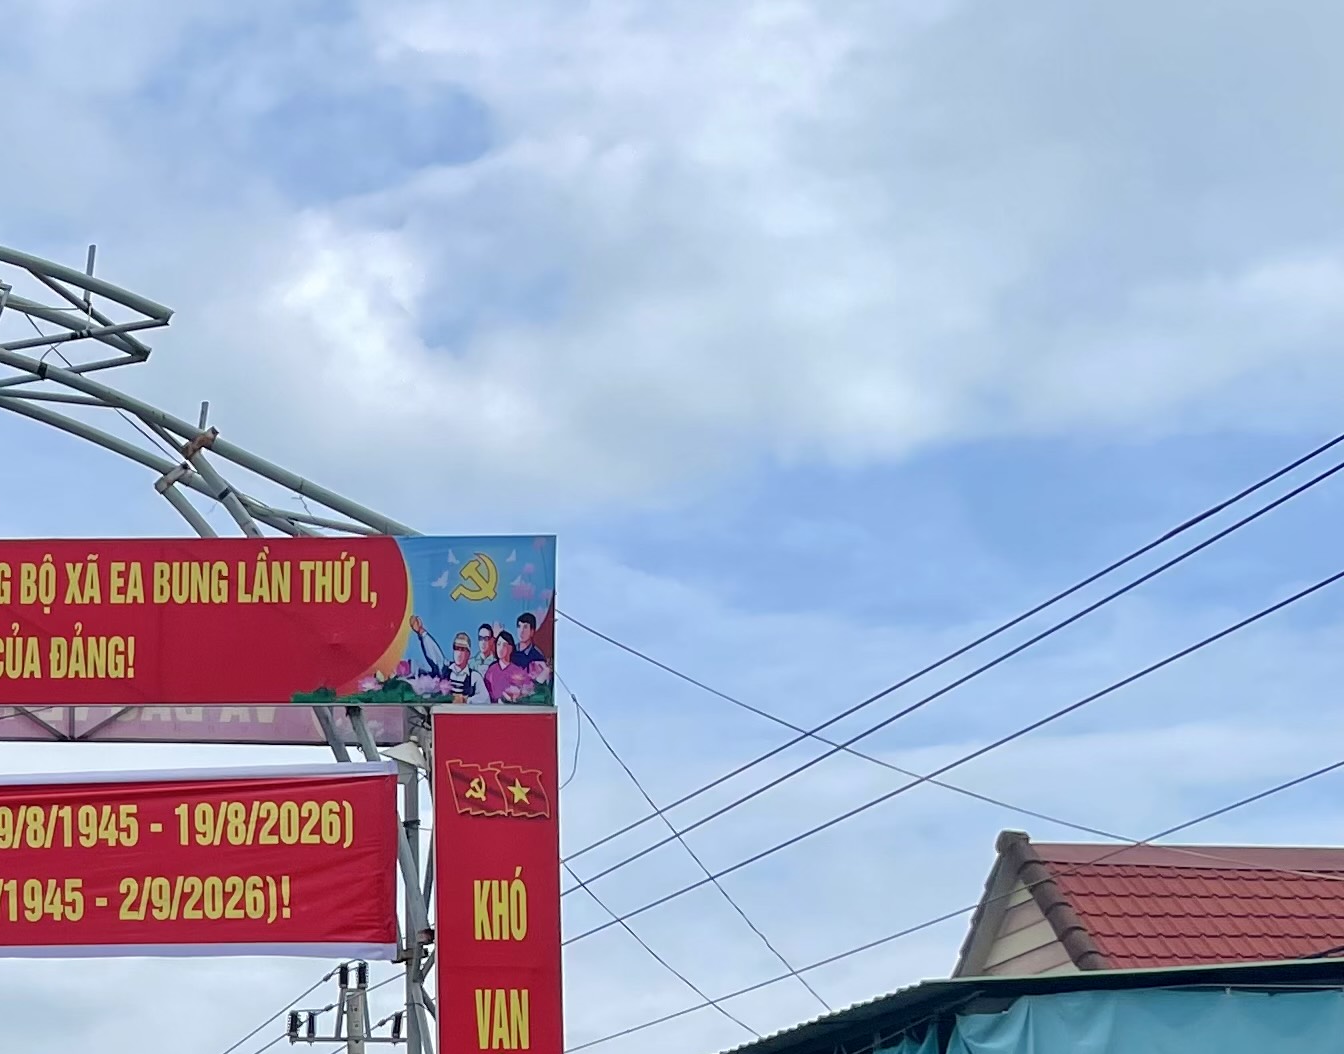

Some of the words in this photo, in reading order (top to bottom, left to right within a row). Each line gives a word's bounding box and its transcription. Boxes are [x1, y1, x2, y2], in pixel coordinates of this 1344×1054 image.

[19, 553, 57, 615] BỘ
[64, 554, 102, 605] XÃ
[109, 561, 146, 604] EA
[152, 560, 230, 605] BUNG
[236, 548, 292, 604] LẦN
[299, 552, 356, 604] THỨ
[359, 560, 378, 608] I,
[48, 623, 136, 679] ĐẢNG!
[149, 822, 163, 834] -
[174, 800, 354, 848] 19/8/2026)
[94, 896, 109, 908] -
[118, 875, 292, 924] 2/9/2026)!
[473, 867, 527, 941] KHÓ
